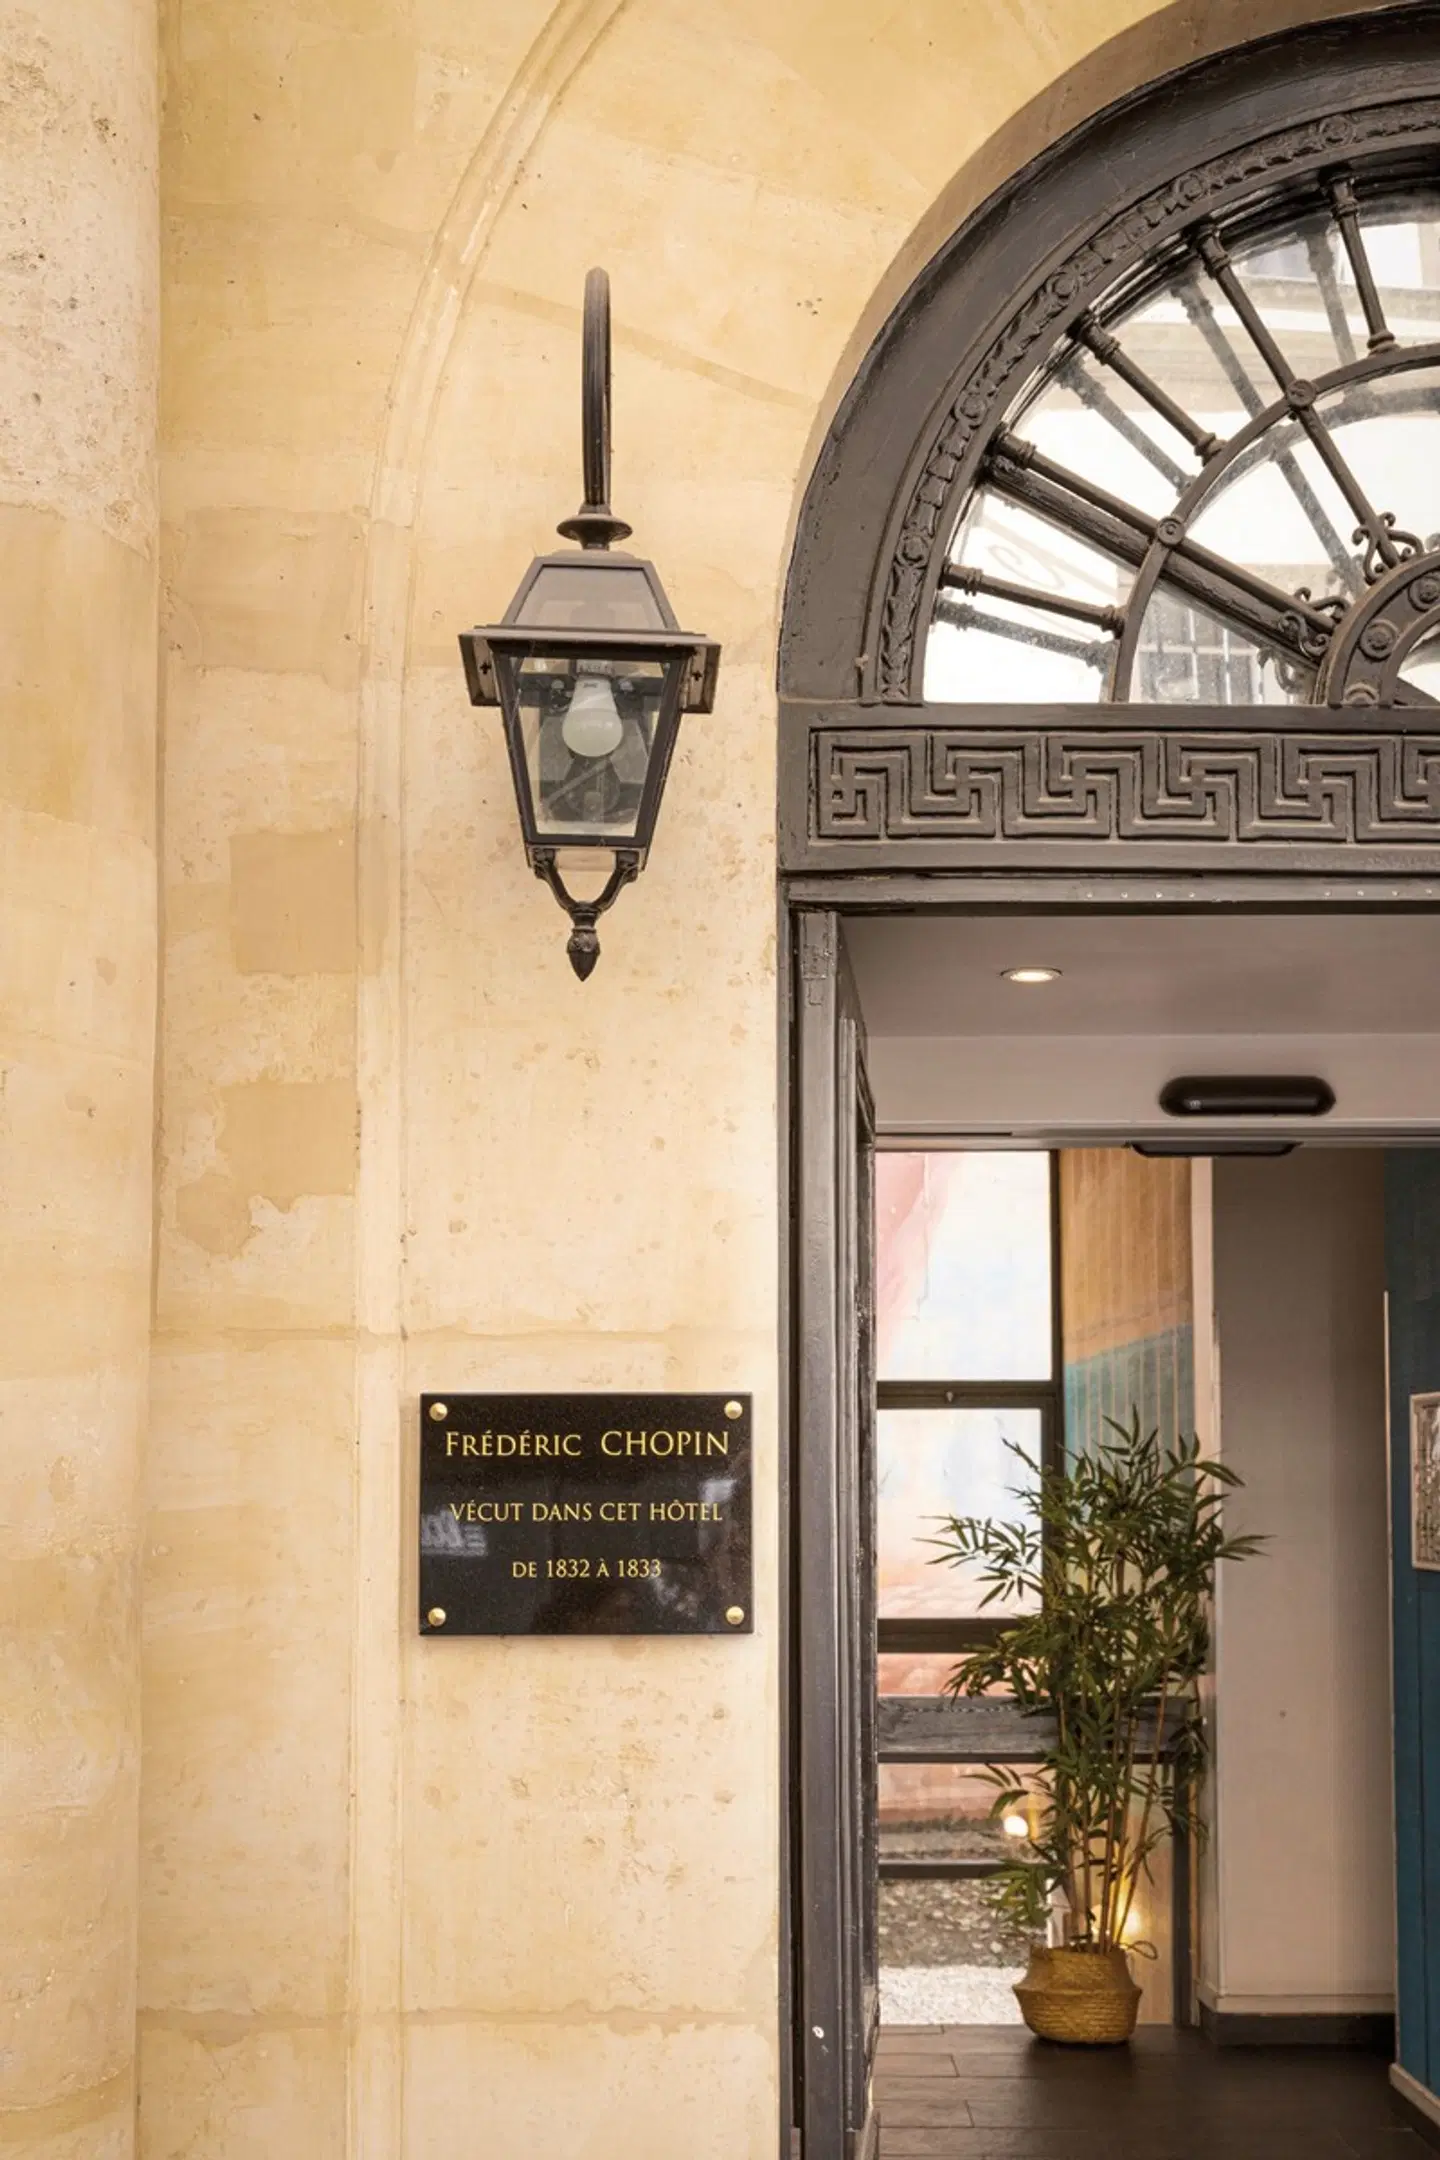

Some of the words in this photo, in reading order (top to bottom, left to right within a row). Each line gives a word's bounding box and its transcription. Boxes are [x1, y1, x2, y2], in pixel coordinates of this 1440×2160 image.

[445, 1430, 582, 1457] FRÉDÉRIC
[600, 1430, 729, 1457] CHOPIN
[450, 1501, 524, 1522] VÉCUT
[532, 1502, 592, 1522] DANS
[600, 1502, 642, 1522] CET
[649, 1499, 723, 1522] HÔTEL
[511, 1561, 537, 1578] DE
[546, 1559, 590, 1578] 1832
[597, 1557, 610, 1578] À
[617, 1558, 662, 1578] 1833
